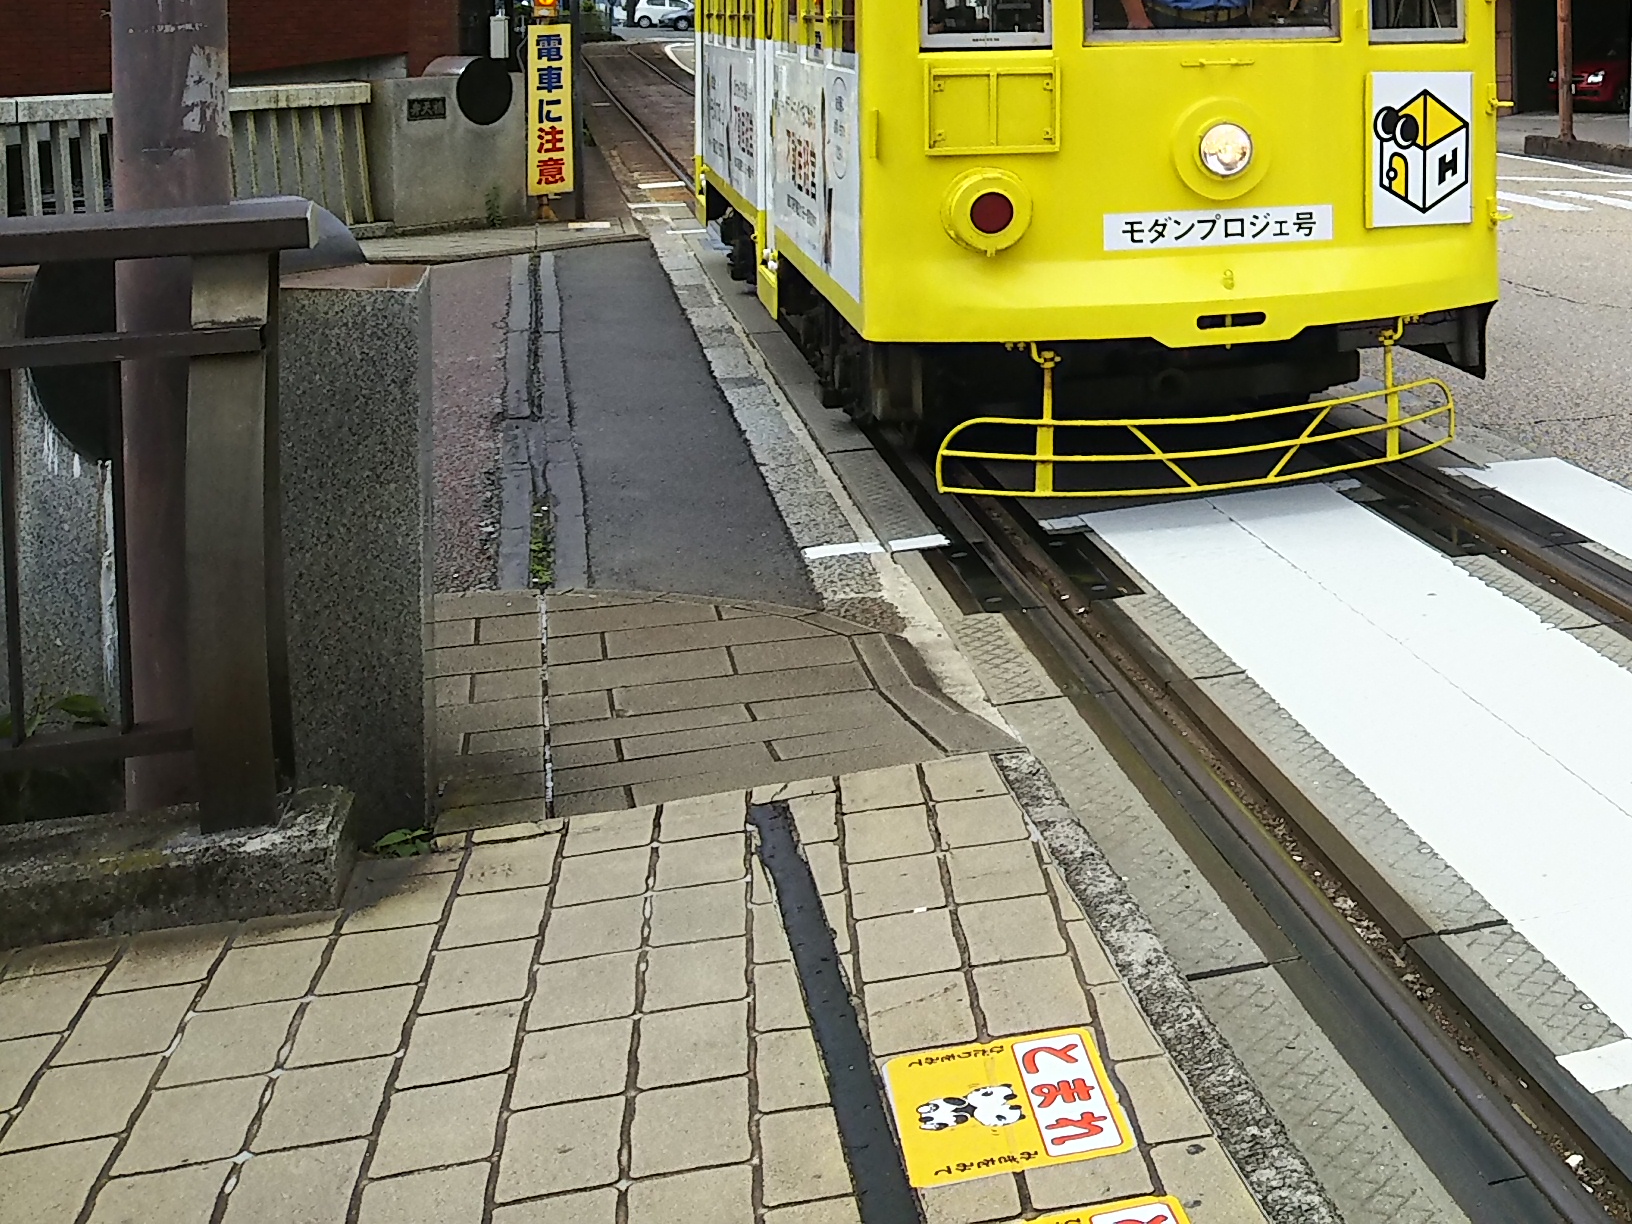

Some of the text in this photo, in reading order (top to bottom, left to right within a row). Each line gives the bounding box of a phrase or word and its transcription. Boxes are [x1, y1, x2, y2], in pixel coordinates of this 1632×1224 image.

[536, 33, 566, 185] 電車に注意
[1437, 147, 1458, 186] H
[1121, 211, 1317, 244] モダンプロジェ号
[1022, 1043, 1108, 1146] とまれ
